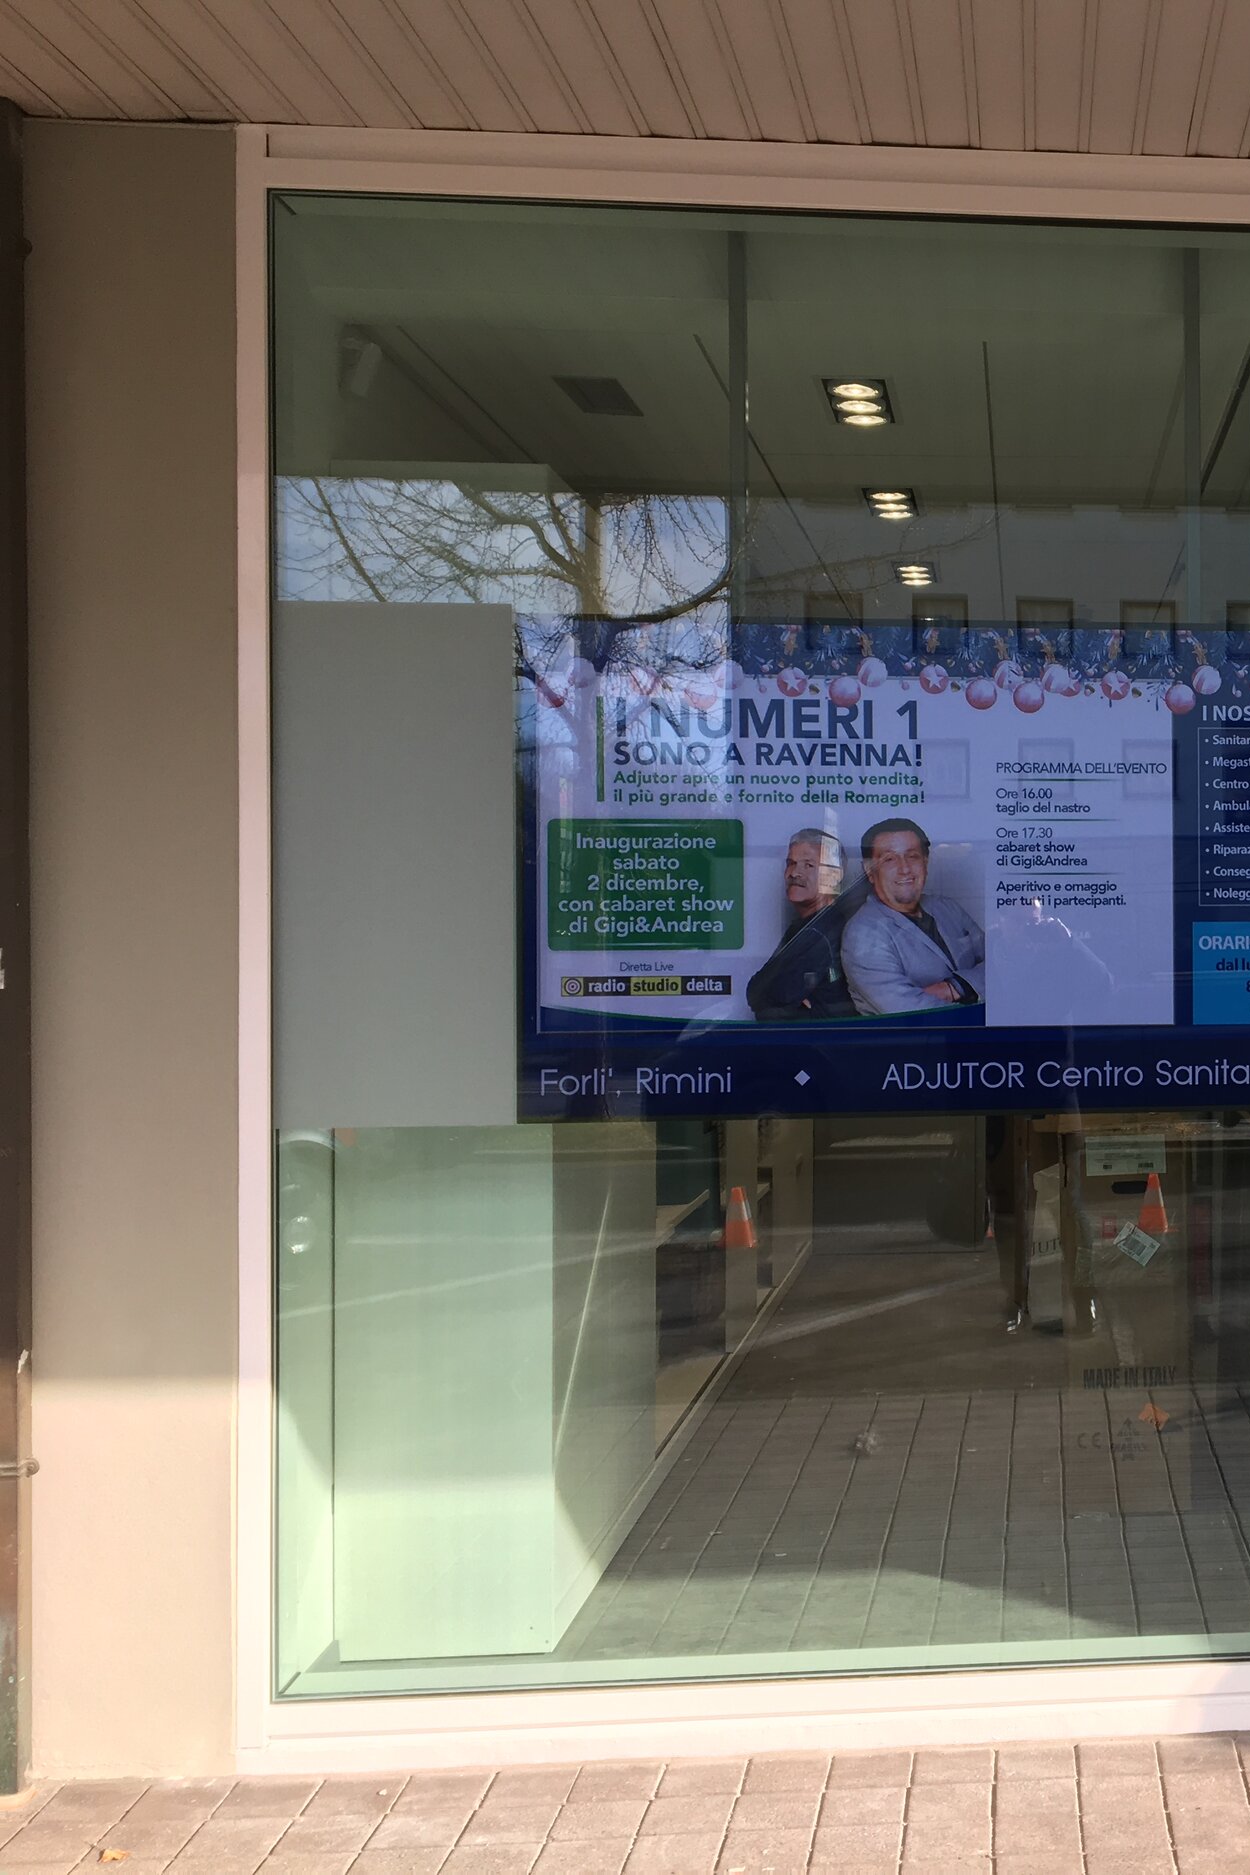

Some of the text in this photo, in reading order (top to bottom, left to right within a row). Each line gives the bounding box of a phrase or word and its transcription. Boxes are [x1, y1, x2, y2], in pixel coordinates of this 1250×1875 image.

[617, 697, 919, 739] I NUMERI 1
[1202, 706, 1207, 722] I
[614, 741, 923, 767] SONO A RAVENNA!
[996, 762, 1082, 775] PROGRAMMA
[614, 771, 924, 788] Adjutor apre un nuovo punto vendita,
[1213, 779, 1249, 789] Centro
[614, 790, 925, 807] il più grande e fornito della Romagna!
[996, 788, 1052, 799] Ore 16.00
[996, 802, 1090, 815] taglio del nastro
[996, 828, 1052, 839] Ore 17.30
[576, 833, 716, 854] Inaugurazione
[996, 842, 1075, 853] cabaret show
[613, 854, 679, 871] sabato
[996, 856, 1088, 868] di Gigi&Andrea
[587, 874, 705, 894] 2 dicembre,
[996, 881, 1050, 895] Aperitivo
[1064, 882, 1117, 895] omaggio
[558, 895, 734, 912] con cabaret show
[996, 896, 1126, 909] per tutti i partecipanti.
[569, 916, 724, 938] di Gigi&Andrea
[620, 962, 674, 971] Diretta Live
[1216, 957, 1238, 971] dal
[588, 978, 724, 994] radio studio delta
[636, 1067, 732, 1095] Rimini
[882, 1062, 1025, 1090] ADJUTOR
[1036, 1060, 1144, 1088] Centro
